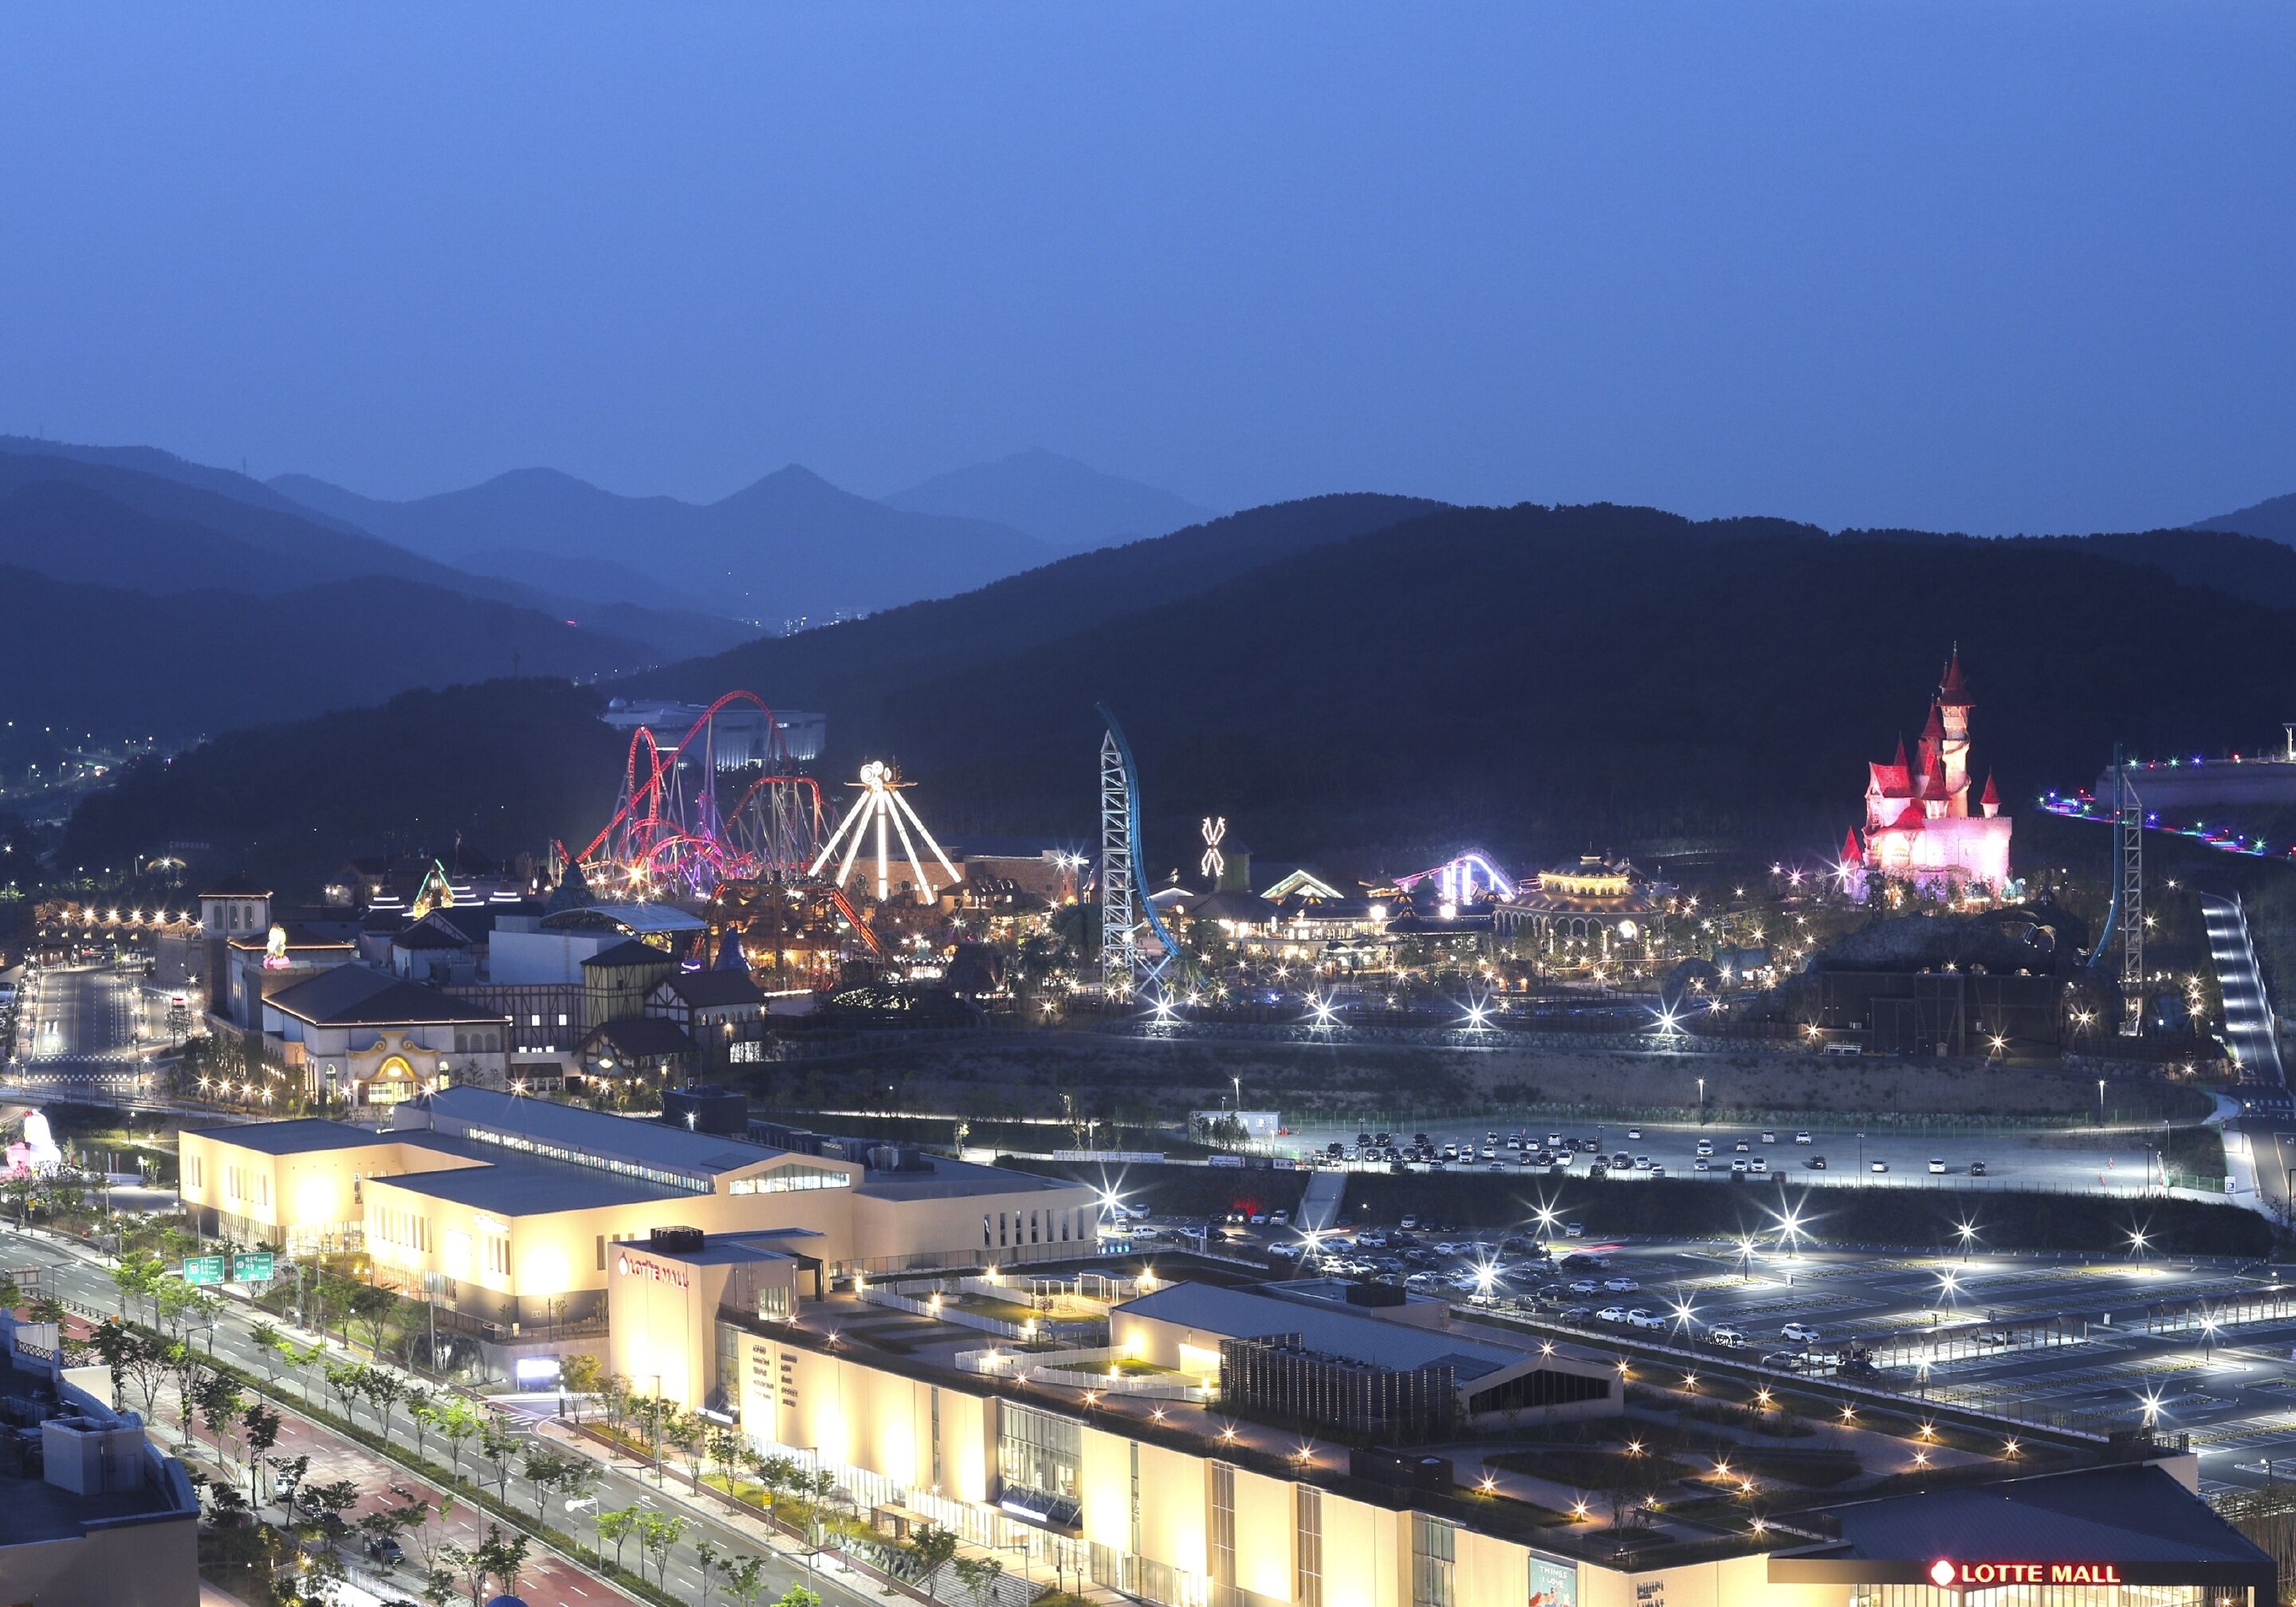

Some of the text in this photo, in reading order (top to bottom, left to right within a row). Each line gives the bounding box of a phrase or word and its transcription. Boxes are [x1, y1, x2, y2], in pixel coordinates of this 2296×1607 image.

[629, 1259, 690, 1290] LOTTE MALL
[1539, 1565, 1568, 1579] THINGS
[1961, 1563, 2121, 1584] LOTTE MALL
[1547, 1576, 1565, 1588] LOVE
